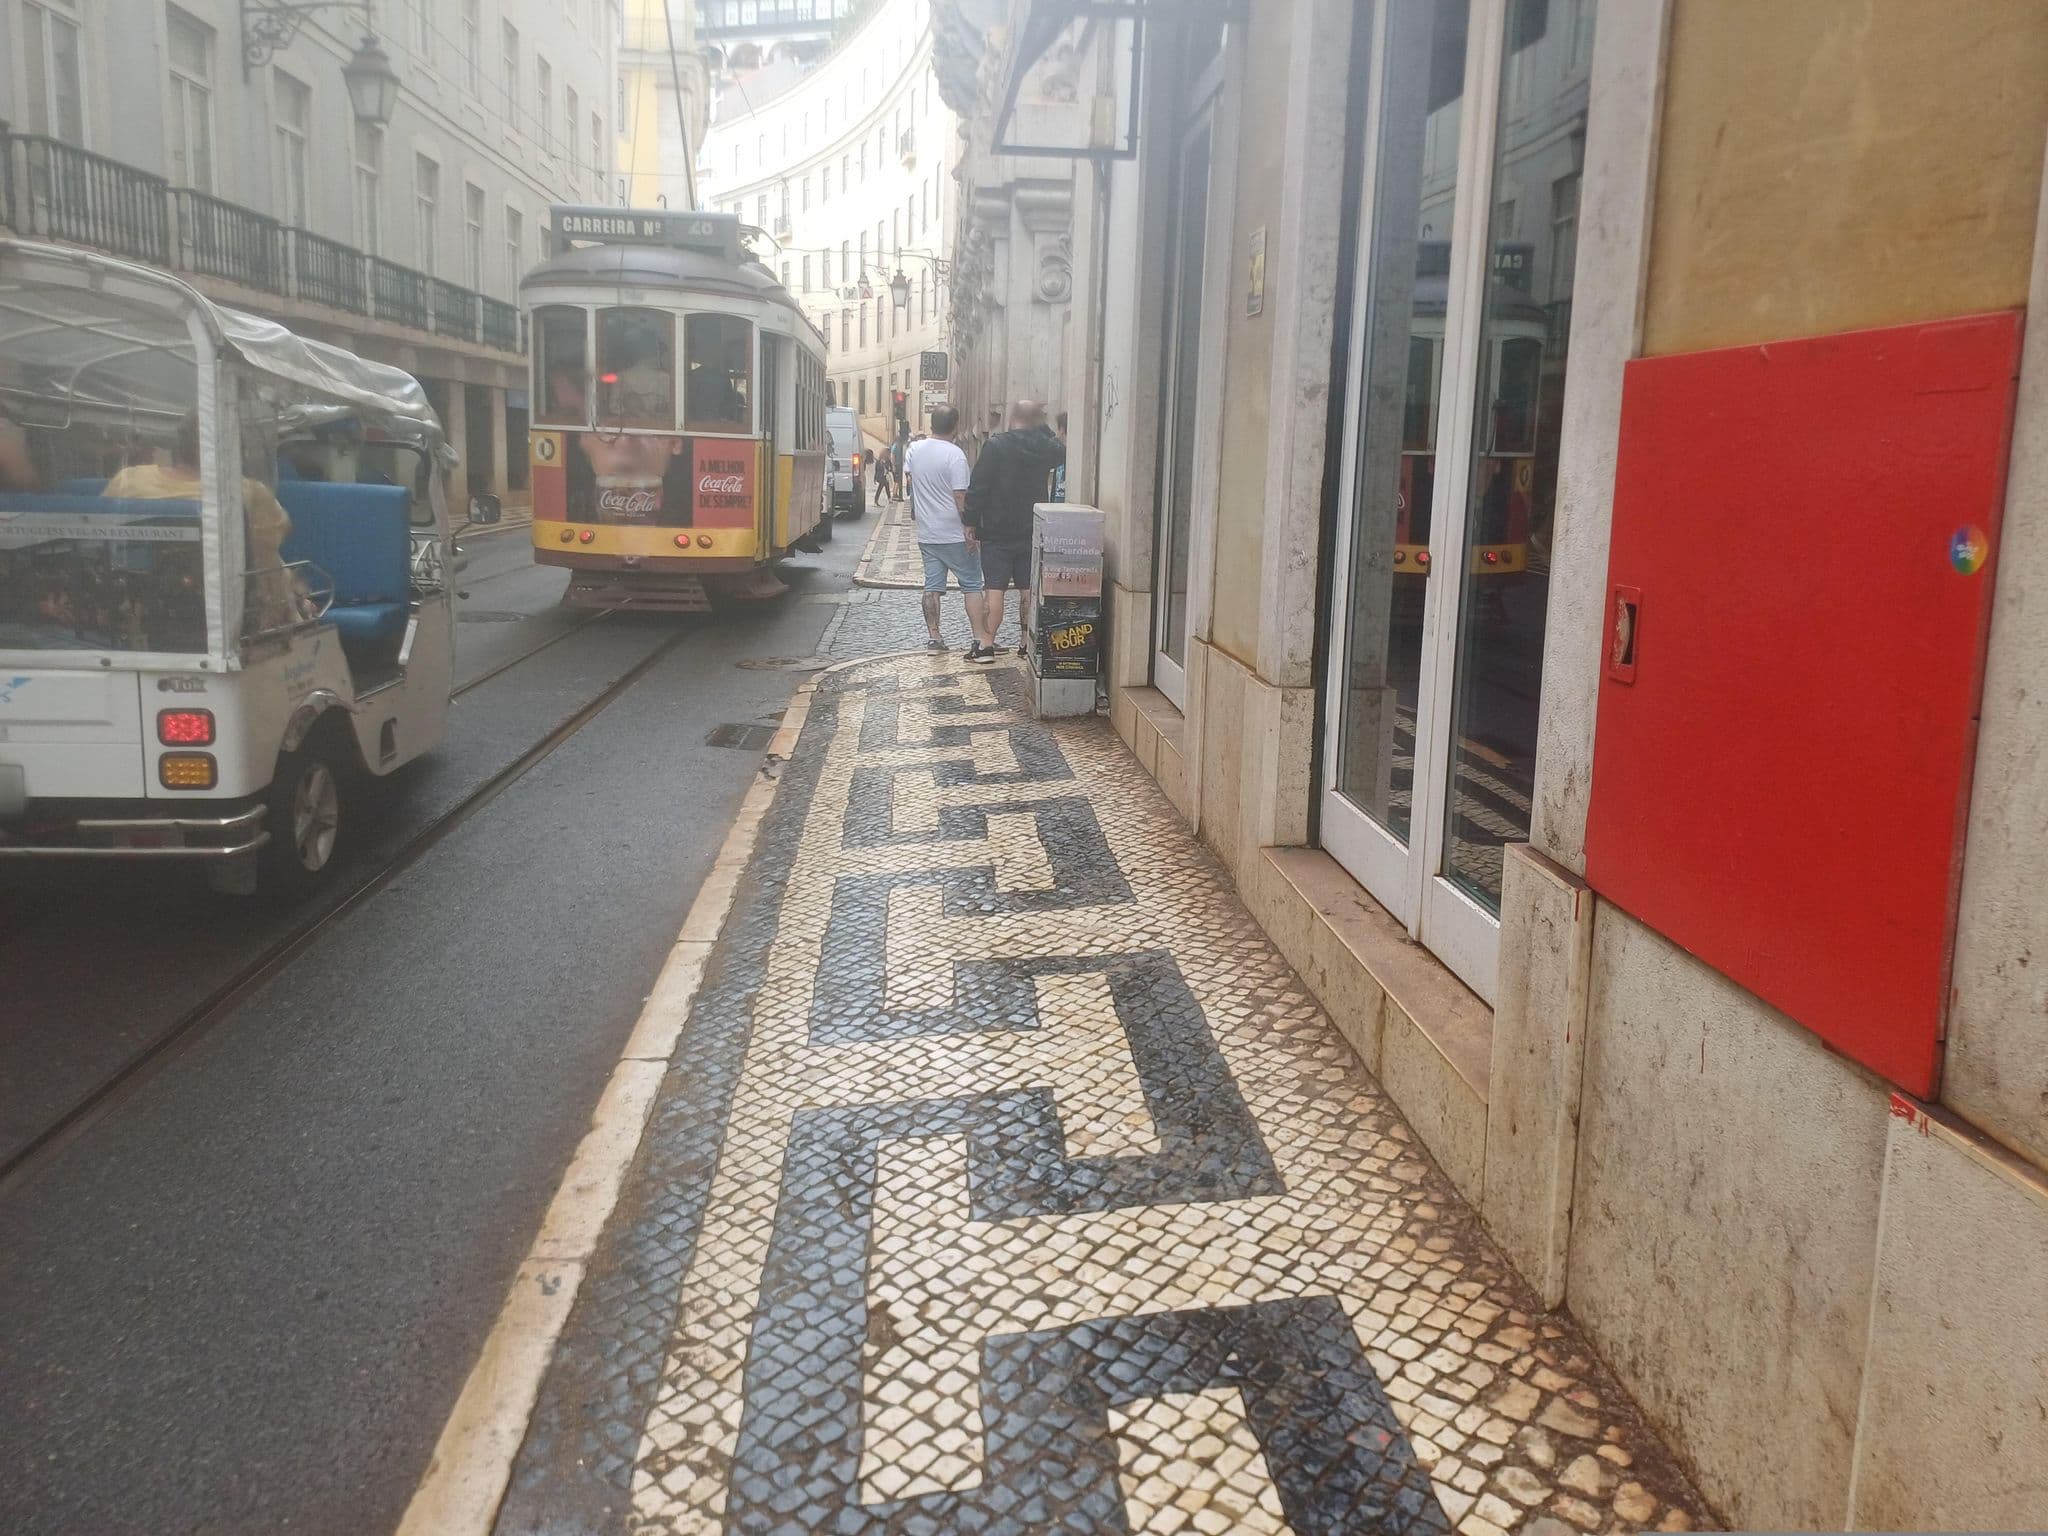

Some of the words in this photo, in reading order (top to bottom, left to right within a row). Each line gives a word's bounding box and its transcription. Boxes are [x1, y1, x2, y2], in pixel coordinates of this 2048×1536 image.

[563, 216, 636, 235] CARREIRA
[699, 475, 744, 493] Coca-Cola
[600, 490, 656, 512] Coca-Cola
[110, 527, 185, 538] RESTAURANT
[1052, 634, 1086, 651] TOUR
